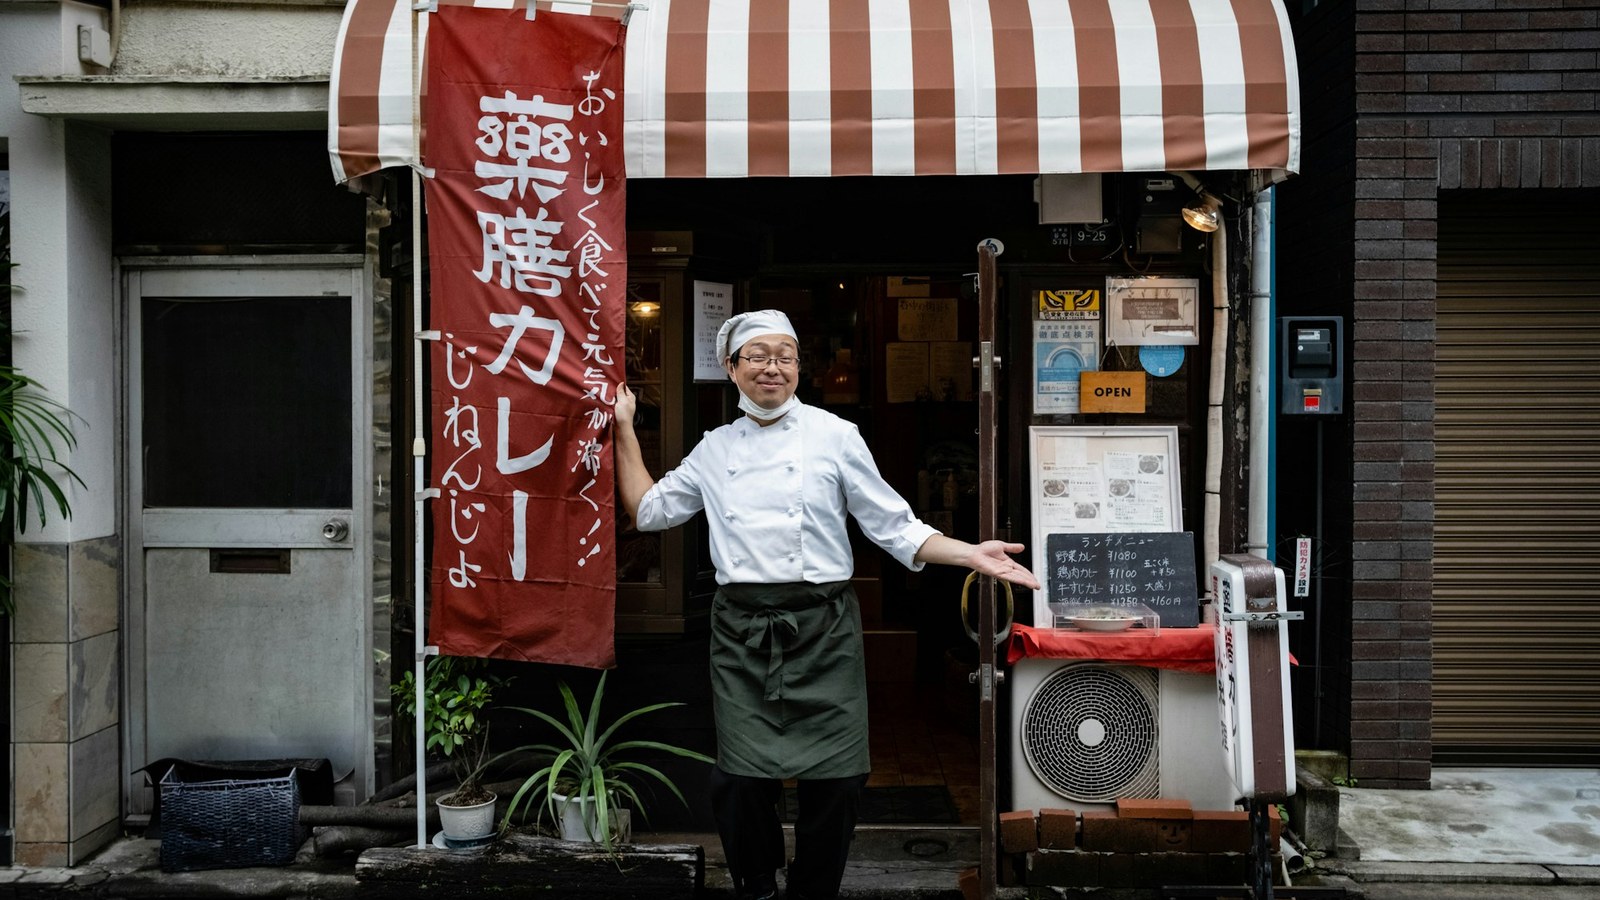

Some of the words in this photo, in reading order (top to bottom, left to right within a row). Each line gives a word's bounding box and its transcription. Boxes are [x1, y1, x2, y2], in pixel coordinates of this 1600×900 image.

[1077, 230, 1107, 242] 9-25
[1094, 387, 1131, 397] OPEN
[441, 333, 485, 589] じねんじょ
[1081, 535, 1154, 547] ランチメニュー
[1055, 549, 1097, 563] 野菜カレー
[1108, 551, 1137, 563] ¥1080
[1057, 566, 1098, 579] 鶏肉カレー
[1109, 567, 1137, 579] ¥1100
[1297, 541, 1309, 594] 防犯カメラ設置
[1057, 581, 1104, 596] 牛すじカレー
[1110, 583, 1137, 595] ¥1250
[1145, 580, 1172, 592] 大盛り
[1150, 595, 1182, 606] +160円
